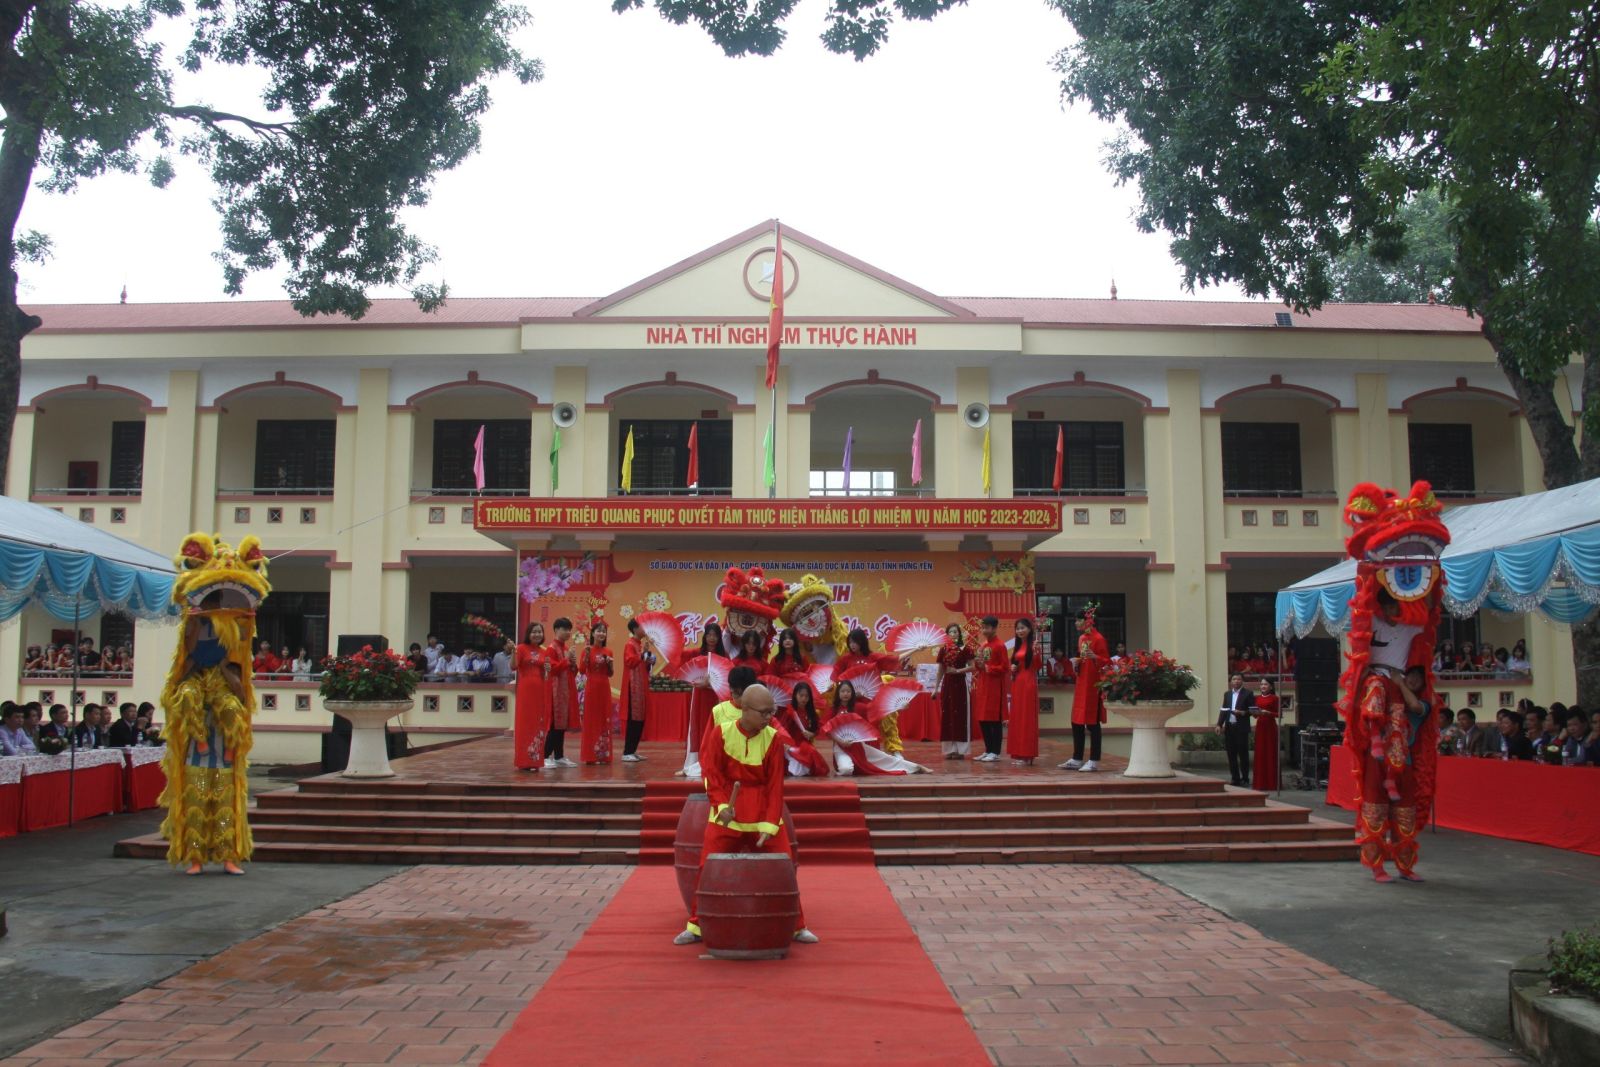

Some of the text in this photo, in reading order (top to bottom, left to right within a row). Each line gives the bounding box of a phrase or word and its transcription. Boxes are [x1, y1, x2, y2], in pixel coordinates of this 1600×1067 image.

[646, 323, 917, 348] NHÀ THÍ NGHM THỰC HÀNH
[485, 503, 1051, 528] TRƯỜNG THPT TRIỆU QUANG PHỤC QUYẾT TÂM THỰC HIỆN THẮNG LỢI NHIỆM VỤ NĂM HỌC 2023-2024
